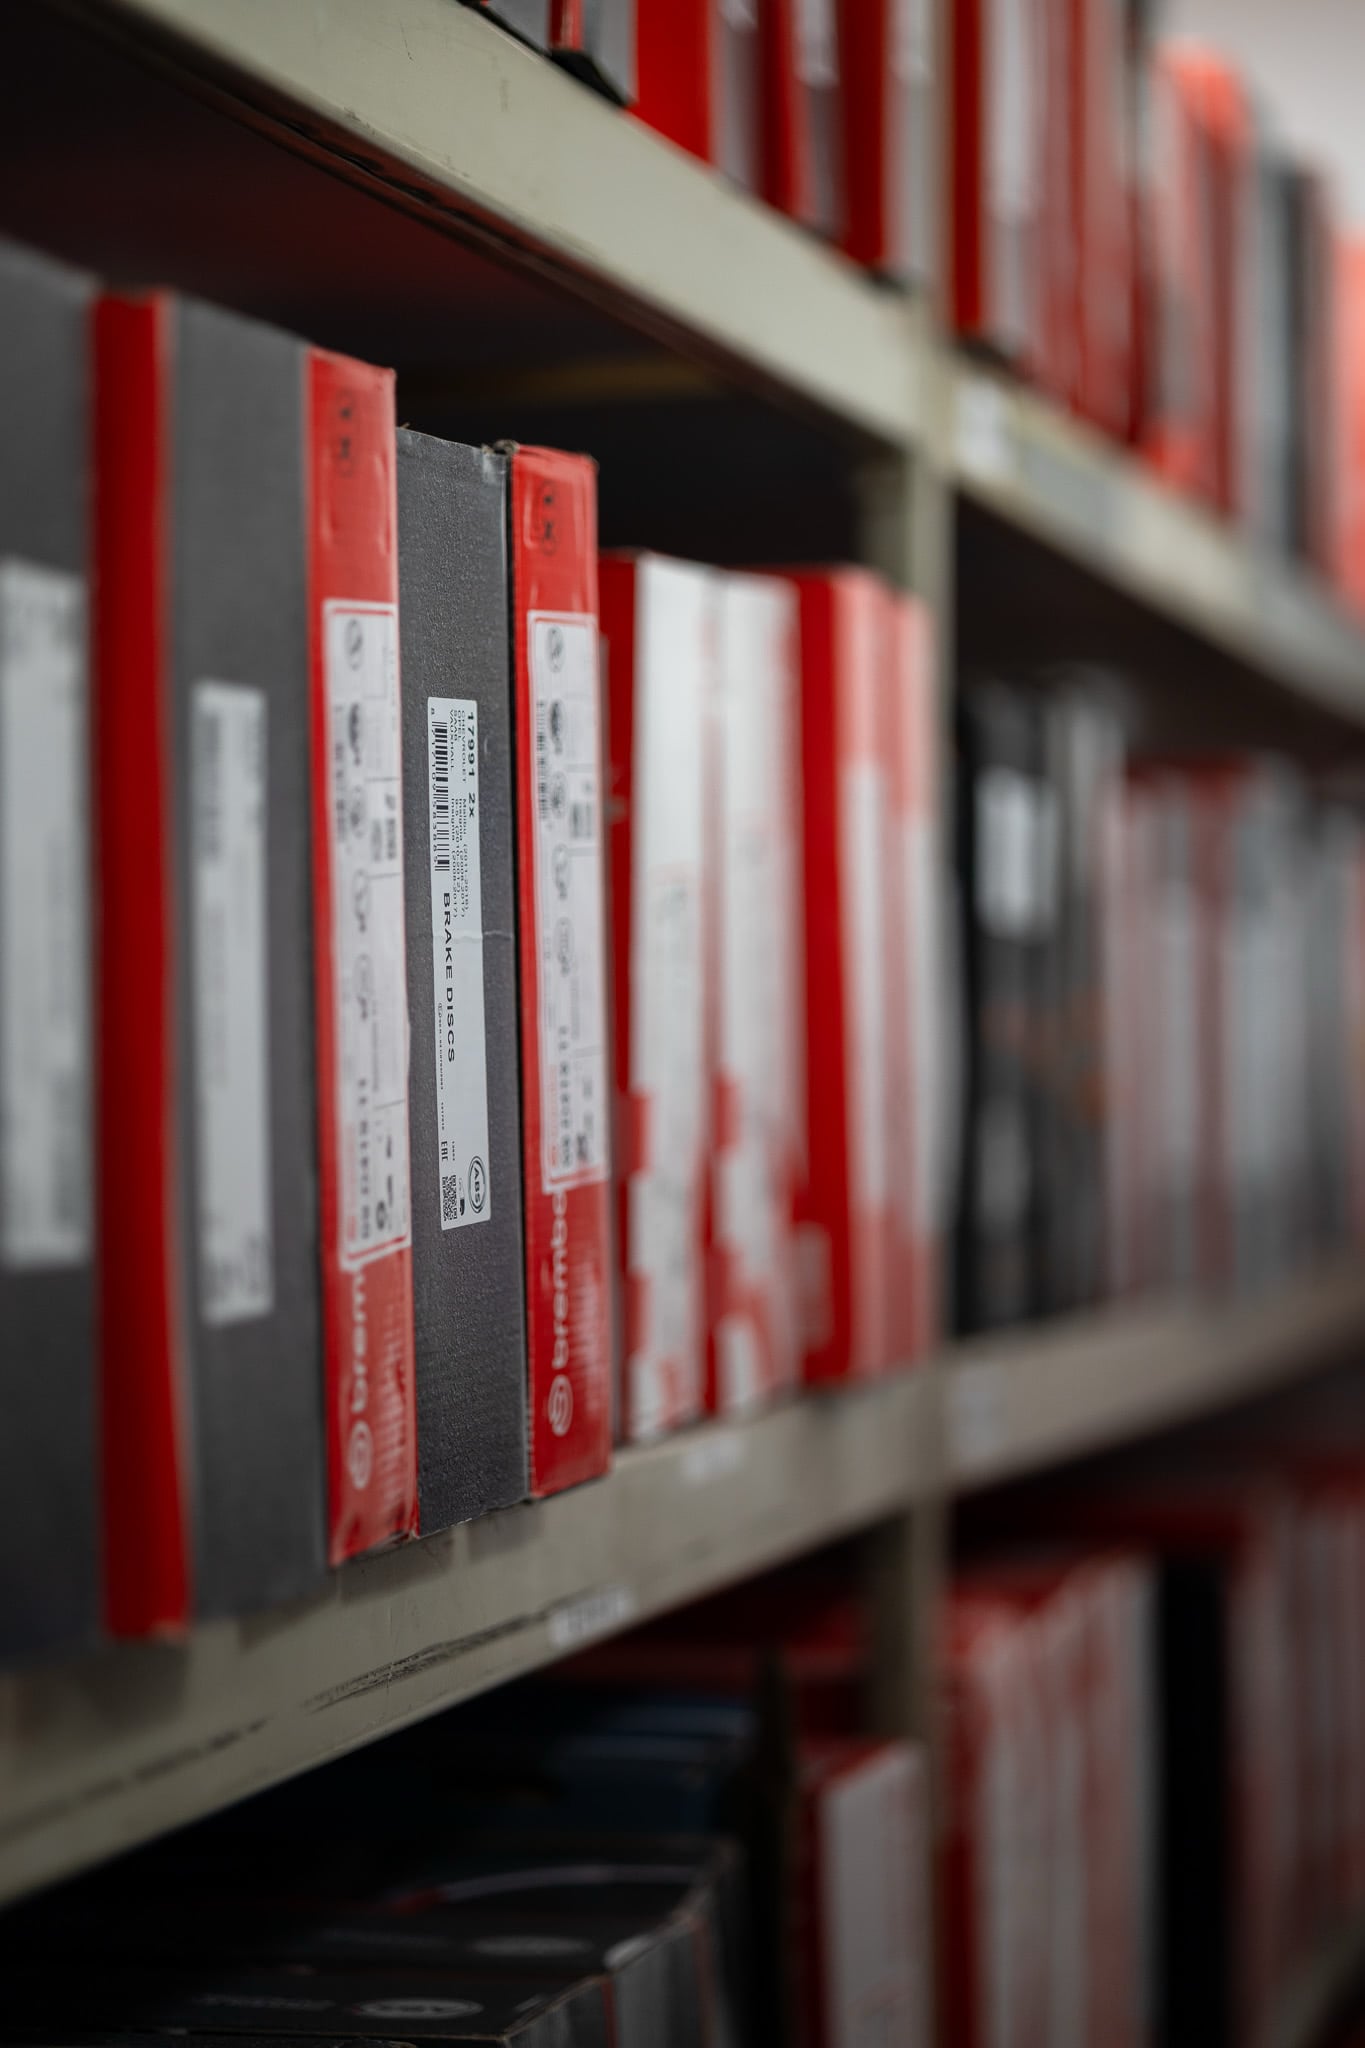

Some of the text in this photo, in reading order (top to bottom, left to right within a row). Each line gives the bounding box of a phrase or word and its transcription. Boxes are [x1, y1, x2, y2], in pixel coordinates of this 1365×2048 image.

[467, 711, 476, 818] 17991 2x
[443, 892, 455, 1063] BRAKE DISCS
[351, 1273, 367, 1413] brem
[551, 1191, 570, 1368] brembo
